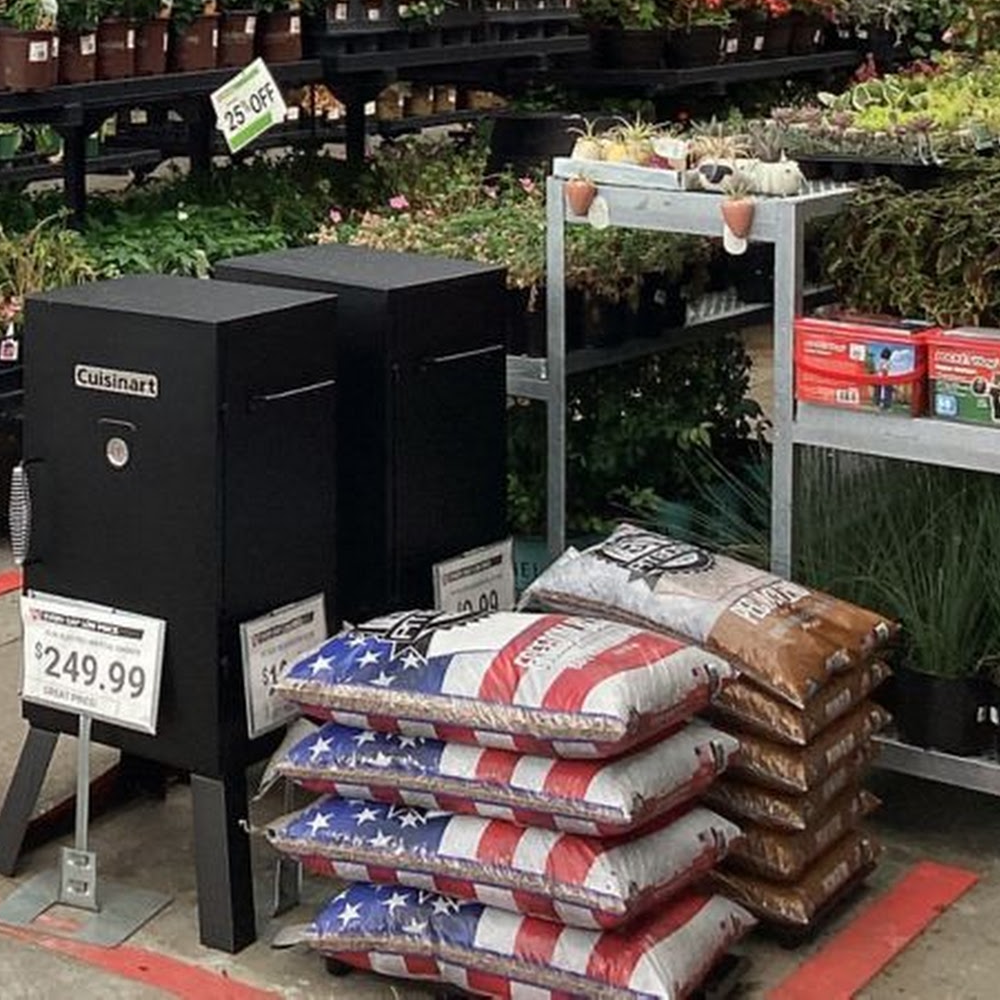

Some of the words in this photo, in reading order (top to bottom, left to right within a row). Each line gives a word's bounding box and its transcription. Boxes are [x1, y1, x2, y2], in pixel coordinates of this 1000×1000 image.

[249, 82, 275, 114] OFF
[76, 368, 156, 395] Cuisinart
[34, 641, 146, 699] $249.99
